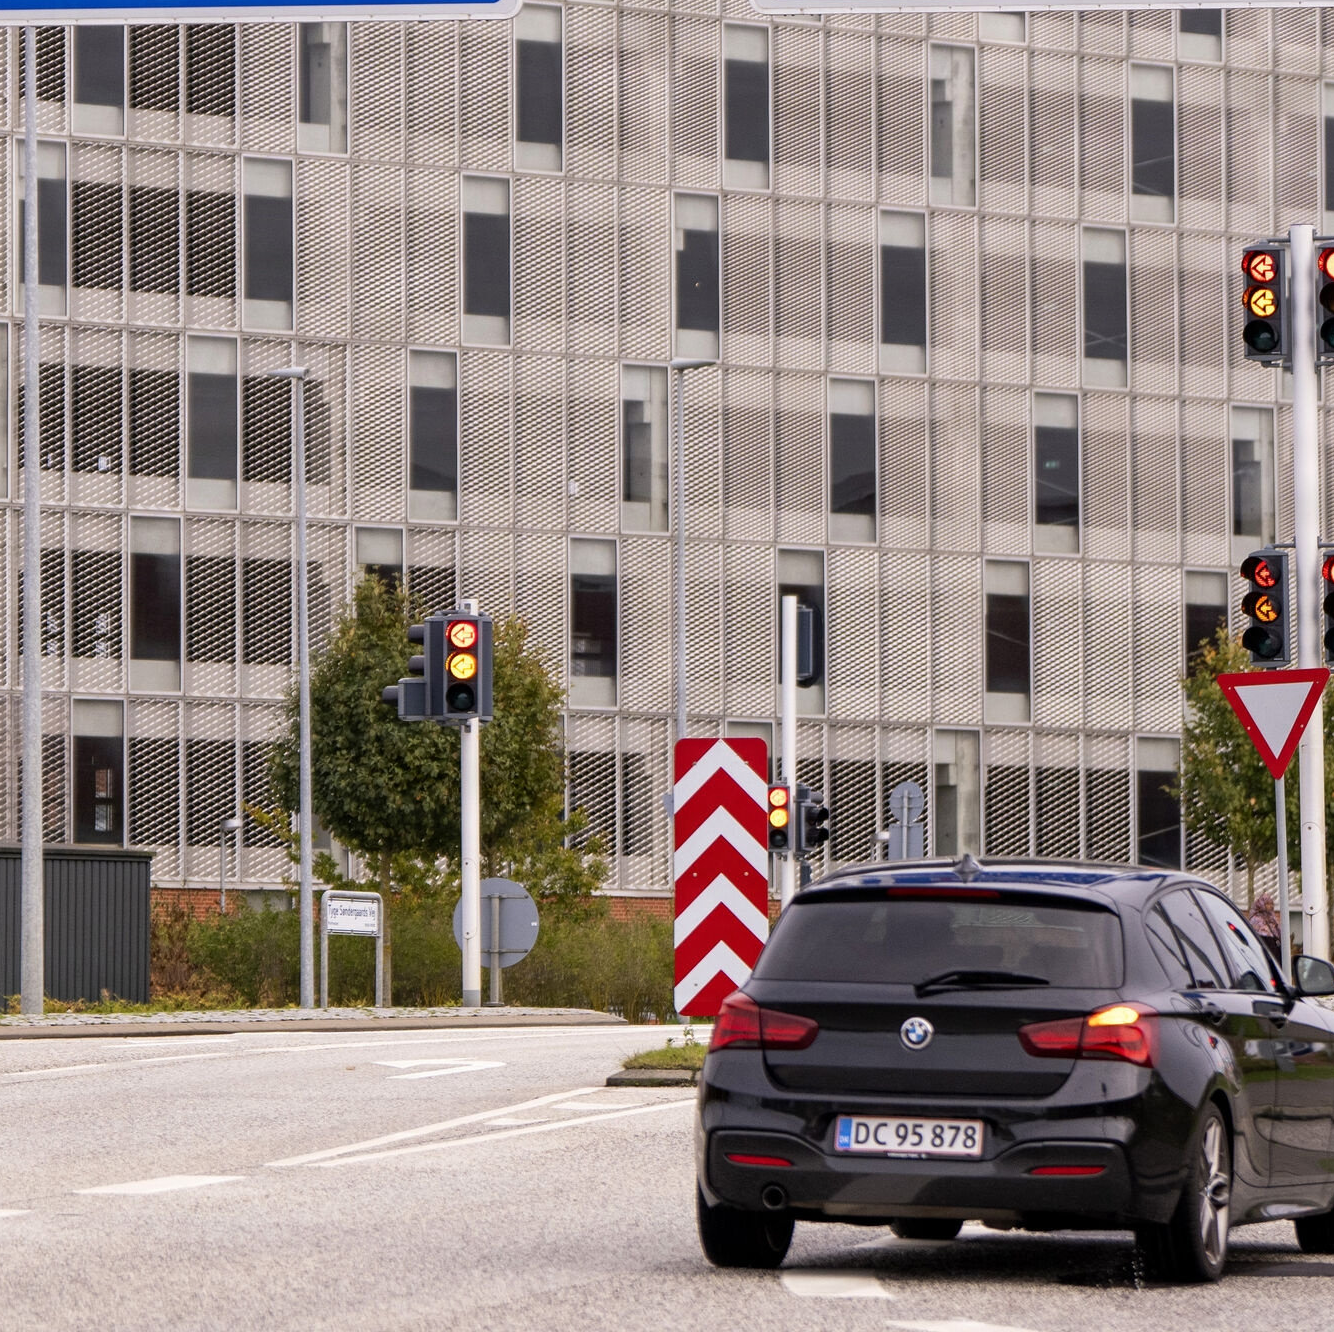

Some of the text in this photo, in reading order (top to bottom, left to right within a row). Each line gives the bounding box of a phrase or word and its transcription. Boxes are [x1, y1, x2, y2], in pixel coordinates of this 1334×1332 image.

[854, 1122, 888, 1146] DC
[895, 1123, 924, 1147] 95
[931, 1124, 977, 1149] 878
